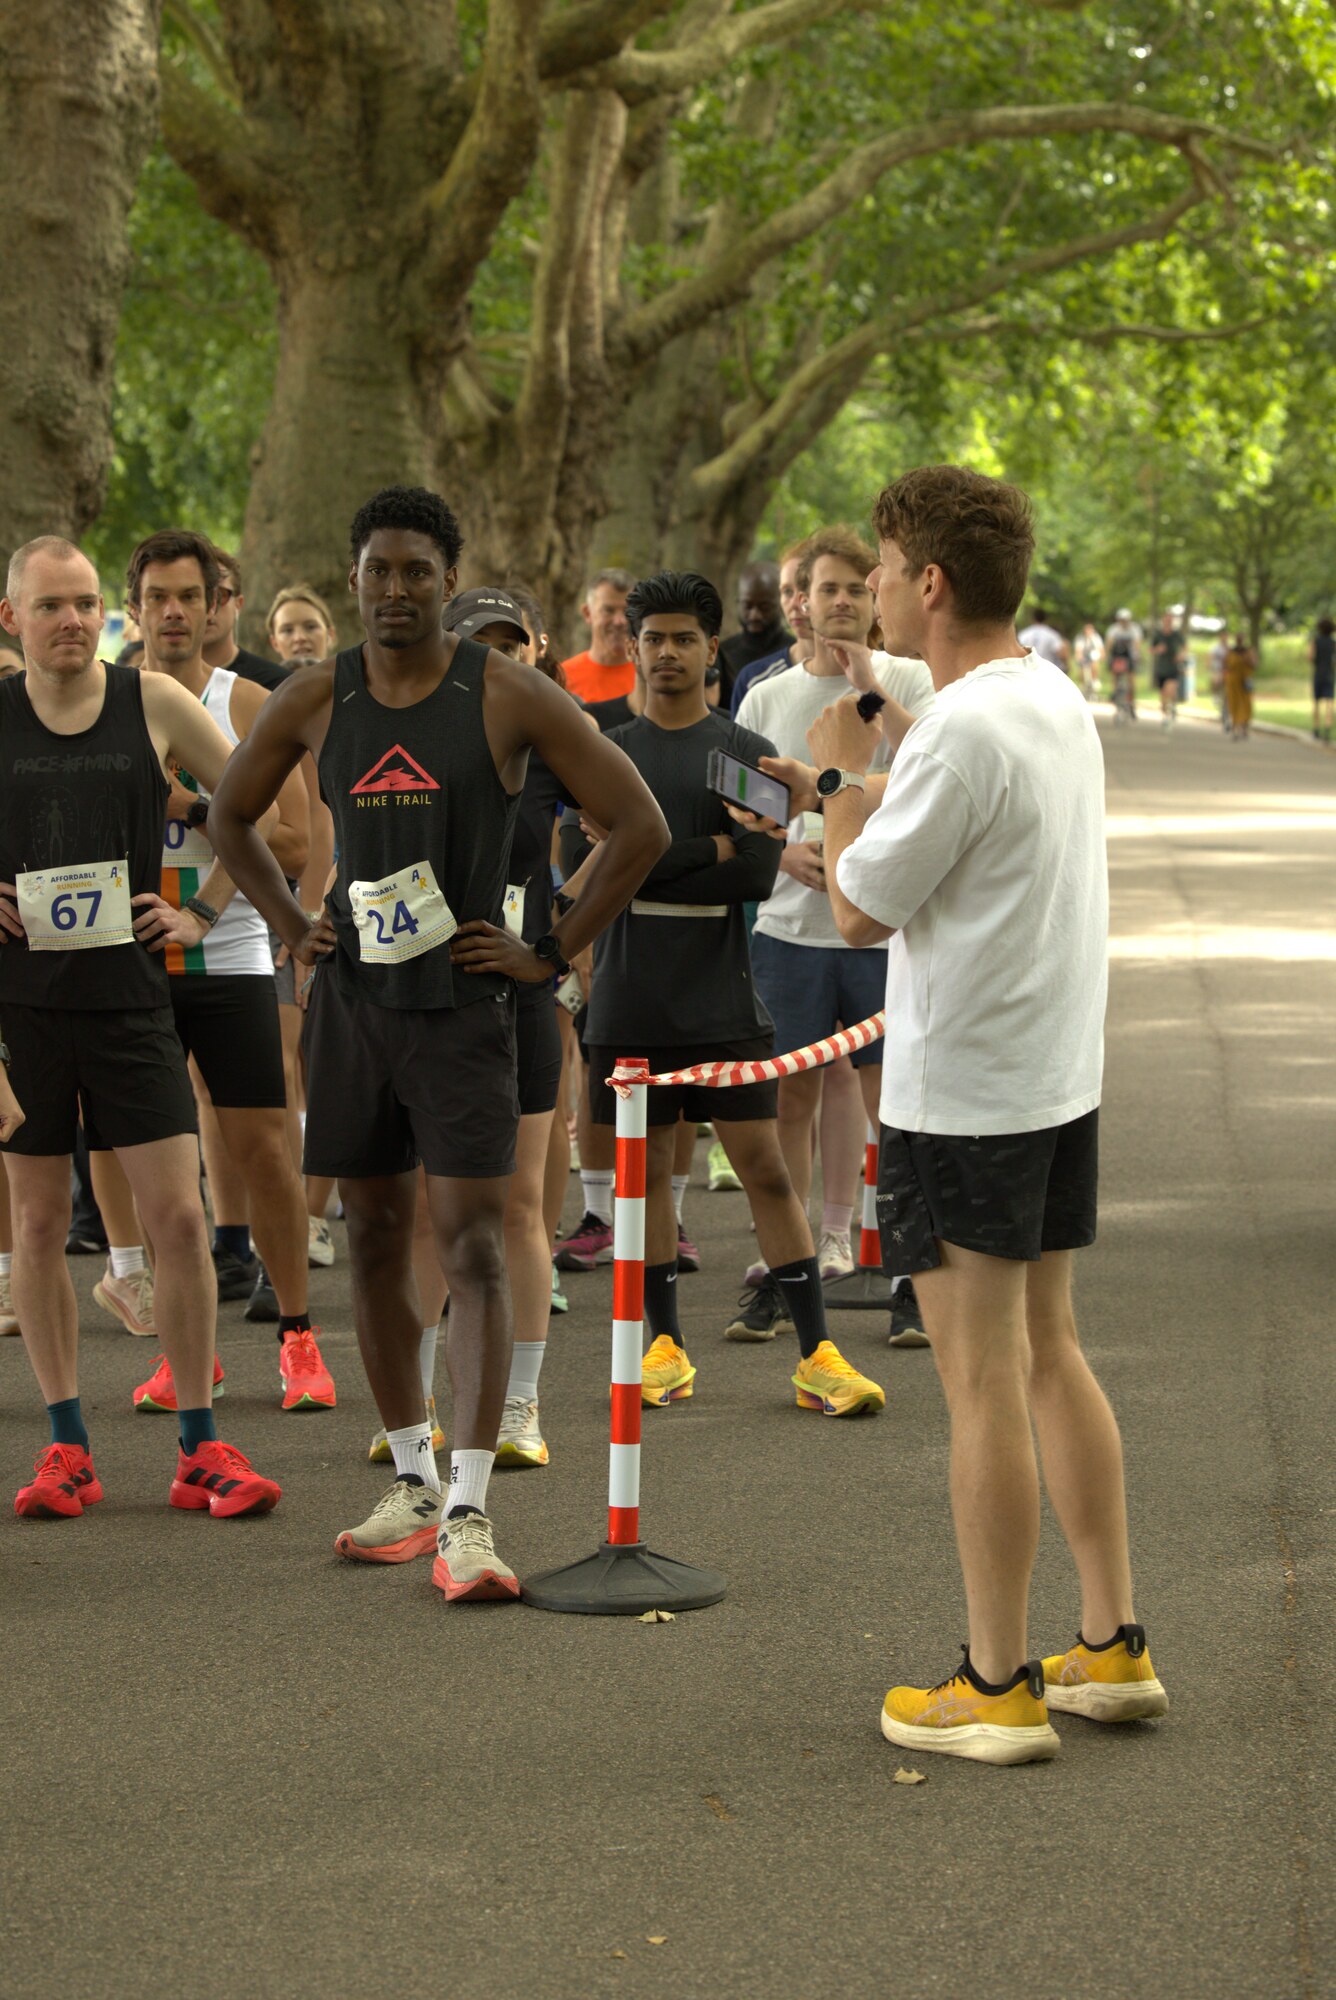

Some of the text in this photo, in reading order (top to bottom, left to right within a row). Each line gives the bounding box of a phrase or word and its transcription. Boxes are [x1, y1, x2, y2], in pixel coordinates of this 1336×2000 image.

[356, 794, 432, 808] NIKE TRAIL
[50, 872, 97, 883] AFFORDABLE
[56, 881, 93, 891] RUNNING
[362, 883, 398, 897] AFFORDABLE
[365, 893, 396, 906] RUNNING
[51, 890, 103, 931] 67
[366, 900, 419, 944] 24
